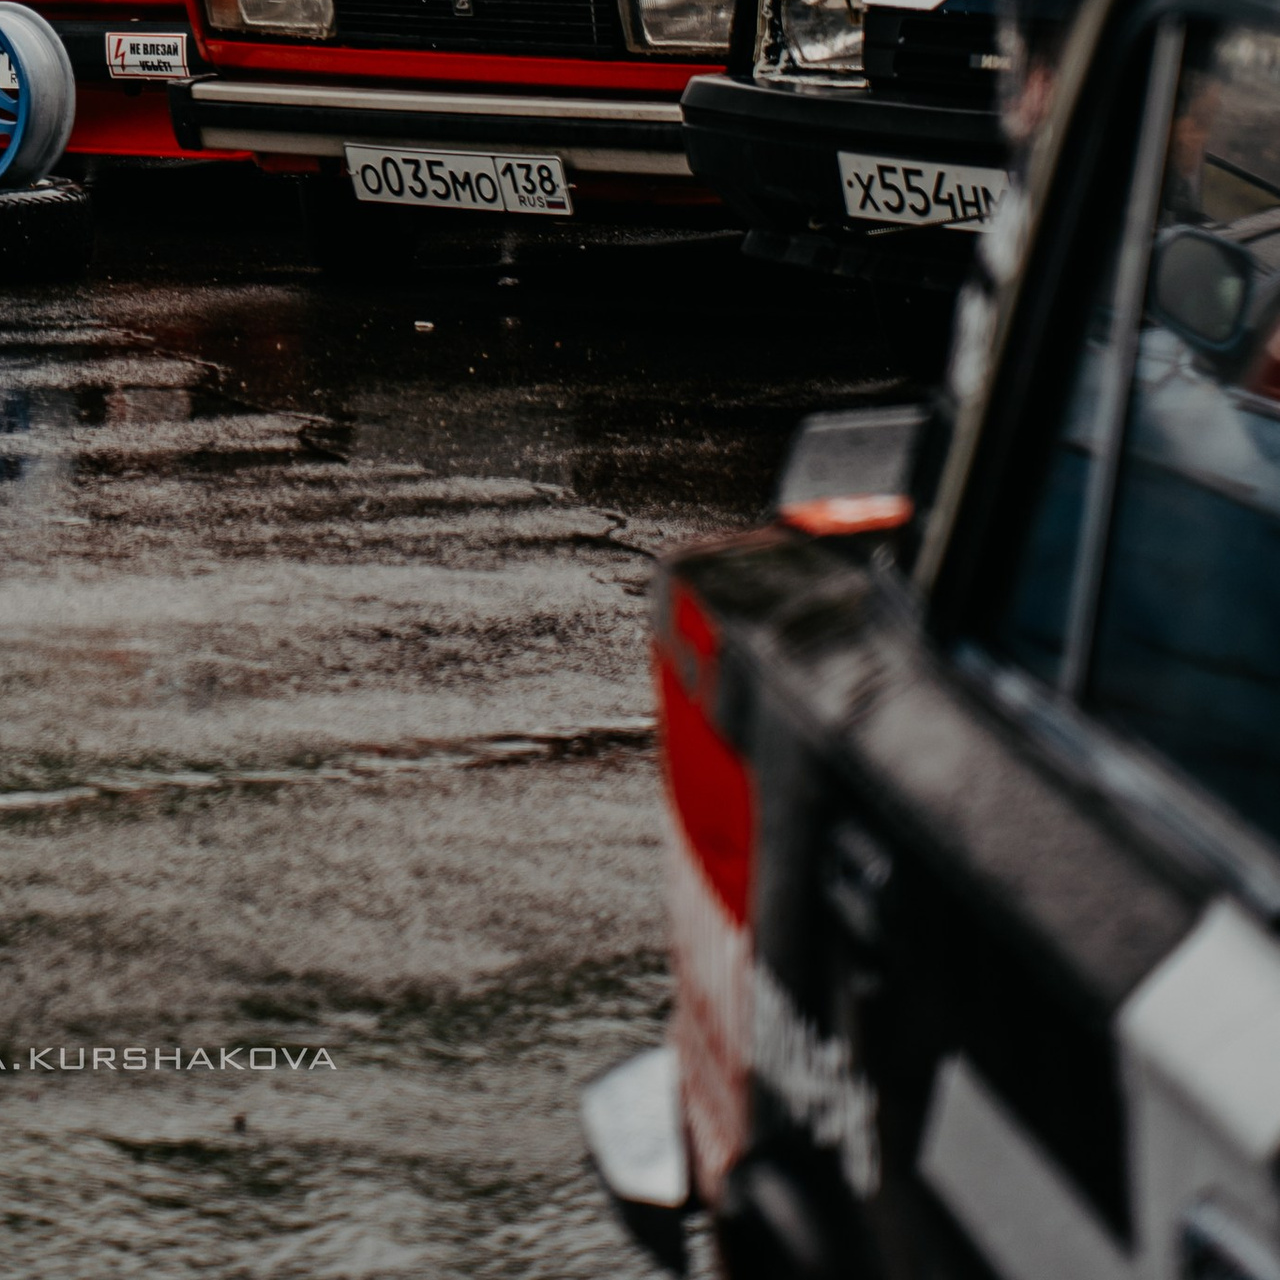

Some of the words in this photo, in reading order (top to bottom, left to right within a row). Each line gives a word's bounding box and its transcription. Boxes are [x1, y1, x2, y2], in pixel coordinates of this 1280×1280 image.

[129, 43, 141, 55] НЕ
[142, 42, 179, 56] ВЛЕЗАЙ
[500, 162, 556, 196] 138
[517, 194, 545, 208] RUS
